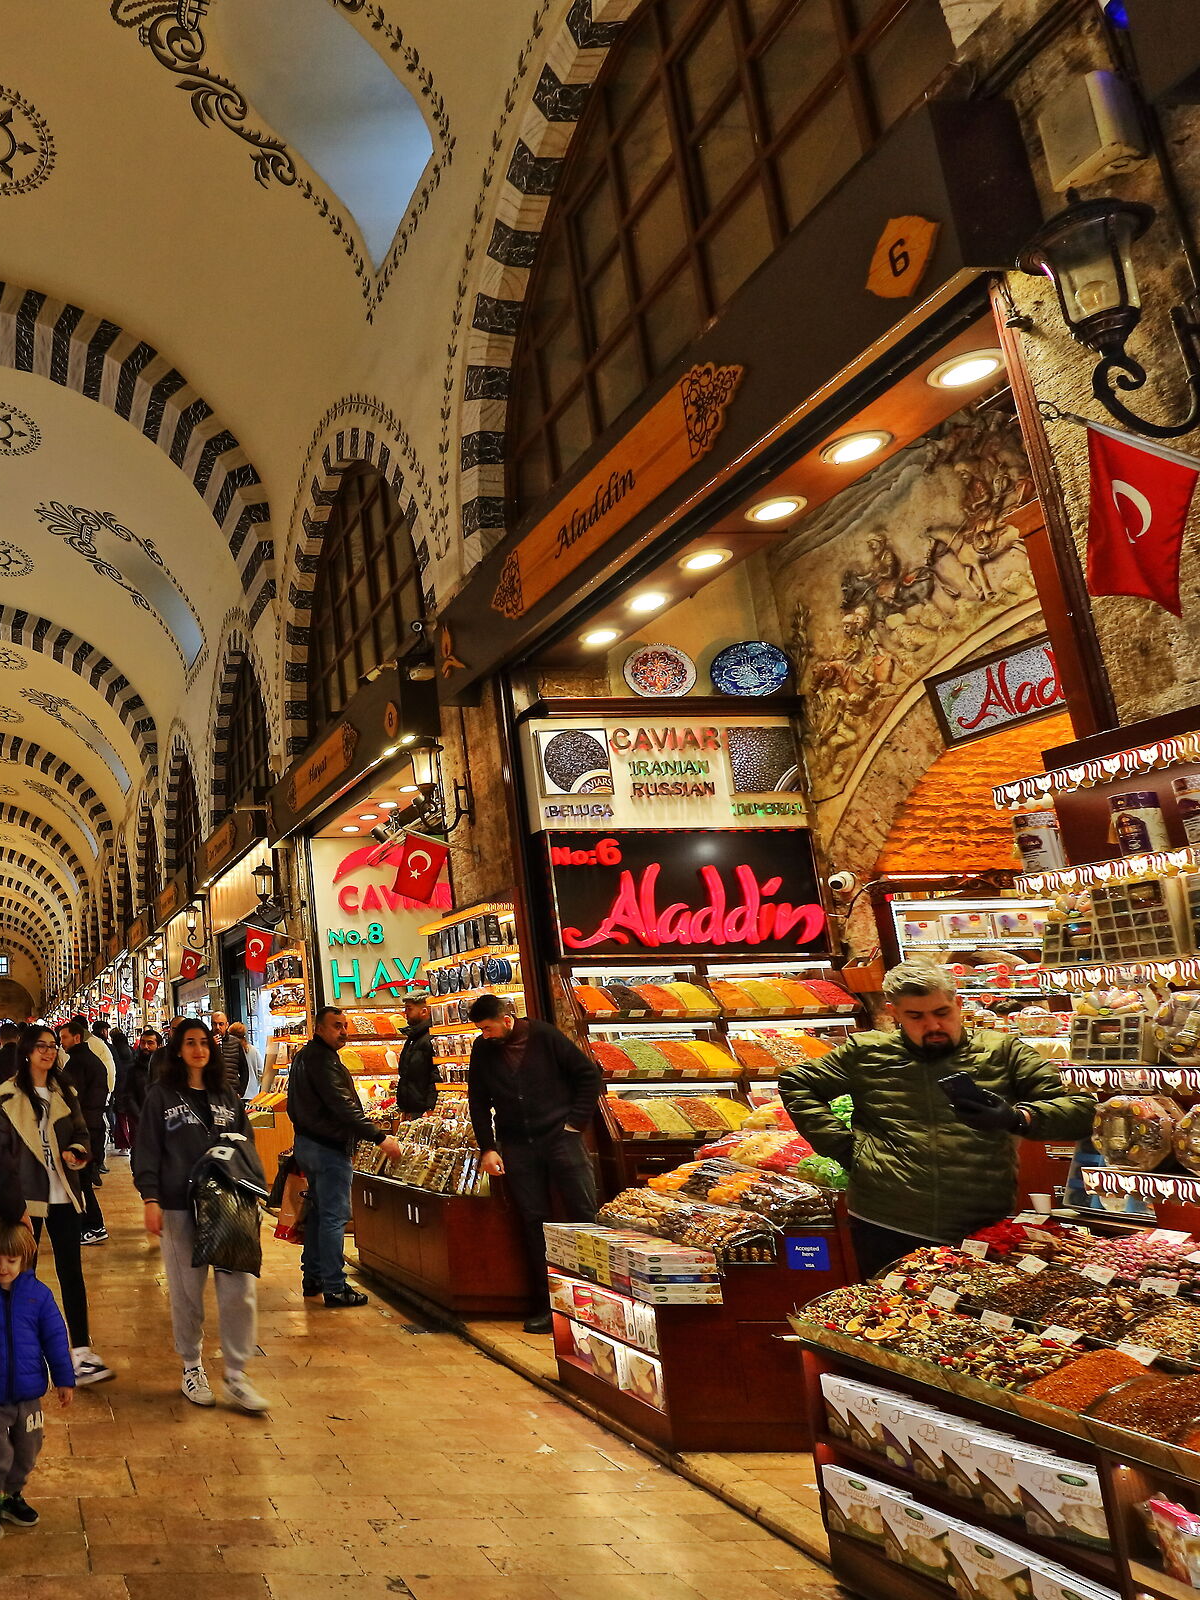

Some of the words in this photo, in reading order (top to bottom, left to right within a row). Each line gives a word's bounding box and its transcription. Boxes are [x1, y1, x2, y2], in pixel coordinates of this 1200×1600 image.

[888, 237, 911, 278] 6
[555, 469, 636, 559] Aladdin
[957, 648, 1066, 729] Alad
[388, 711, 394, 727] 8
[610, 727, 722, 752] CAVIAR
[629, 760, 710, 777] IRANIAN
[631, 781, 717, 799] RUSSIAN
[545, 803, 615, 818] BELUGA
[338, 883, 453, 913] CAVR
[561, 862, 826, 949] Aladdin
[327, 922, 385, 947] No.8
[331, 957, 431, 999] HAY
